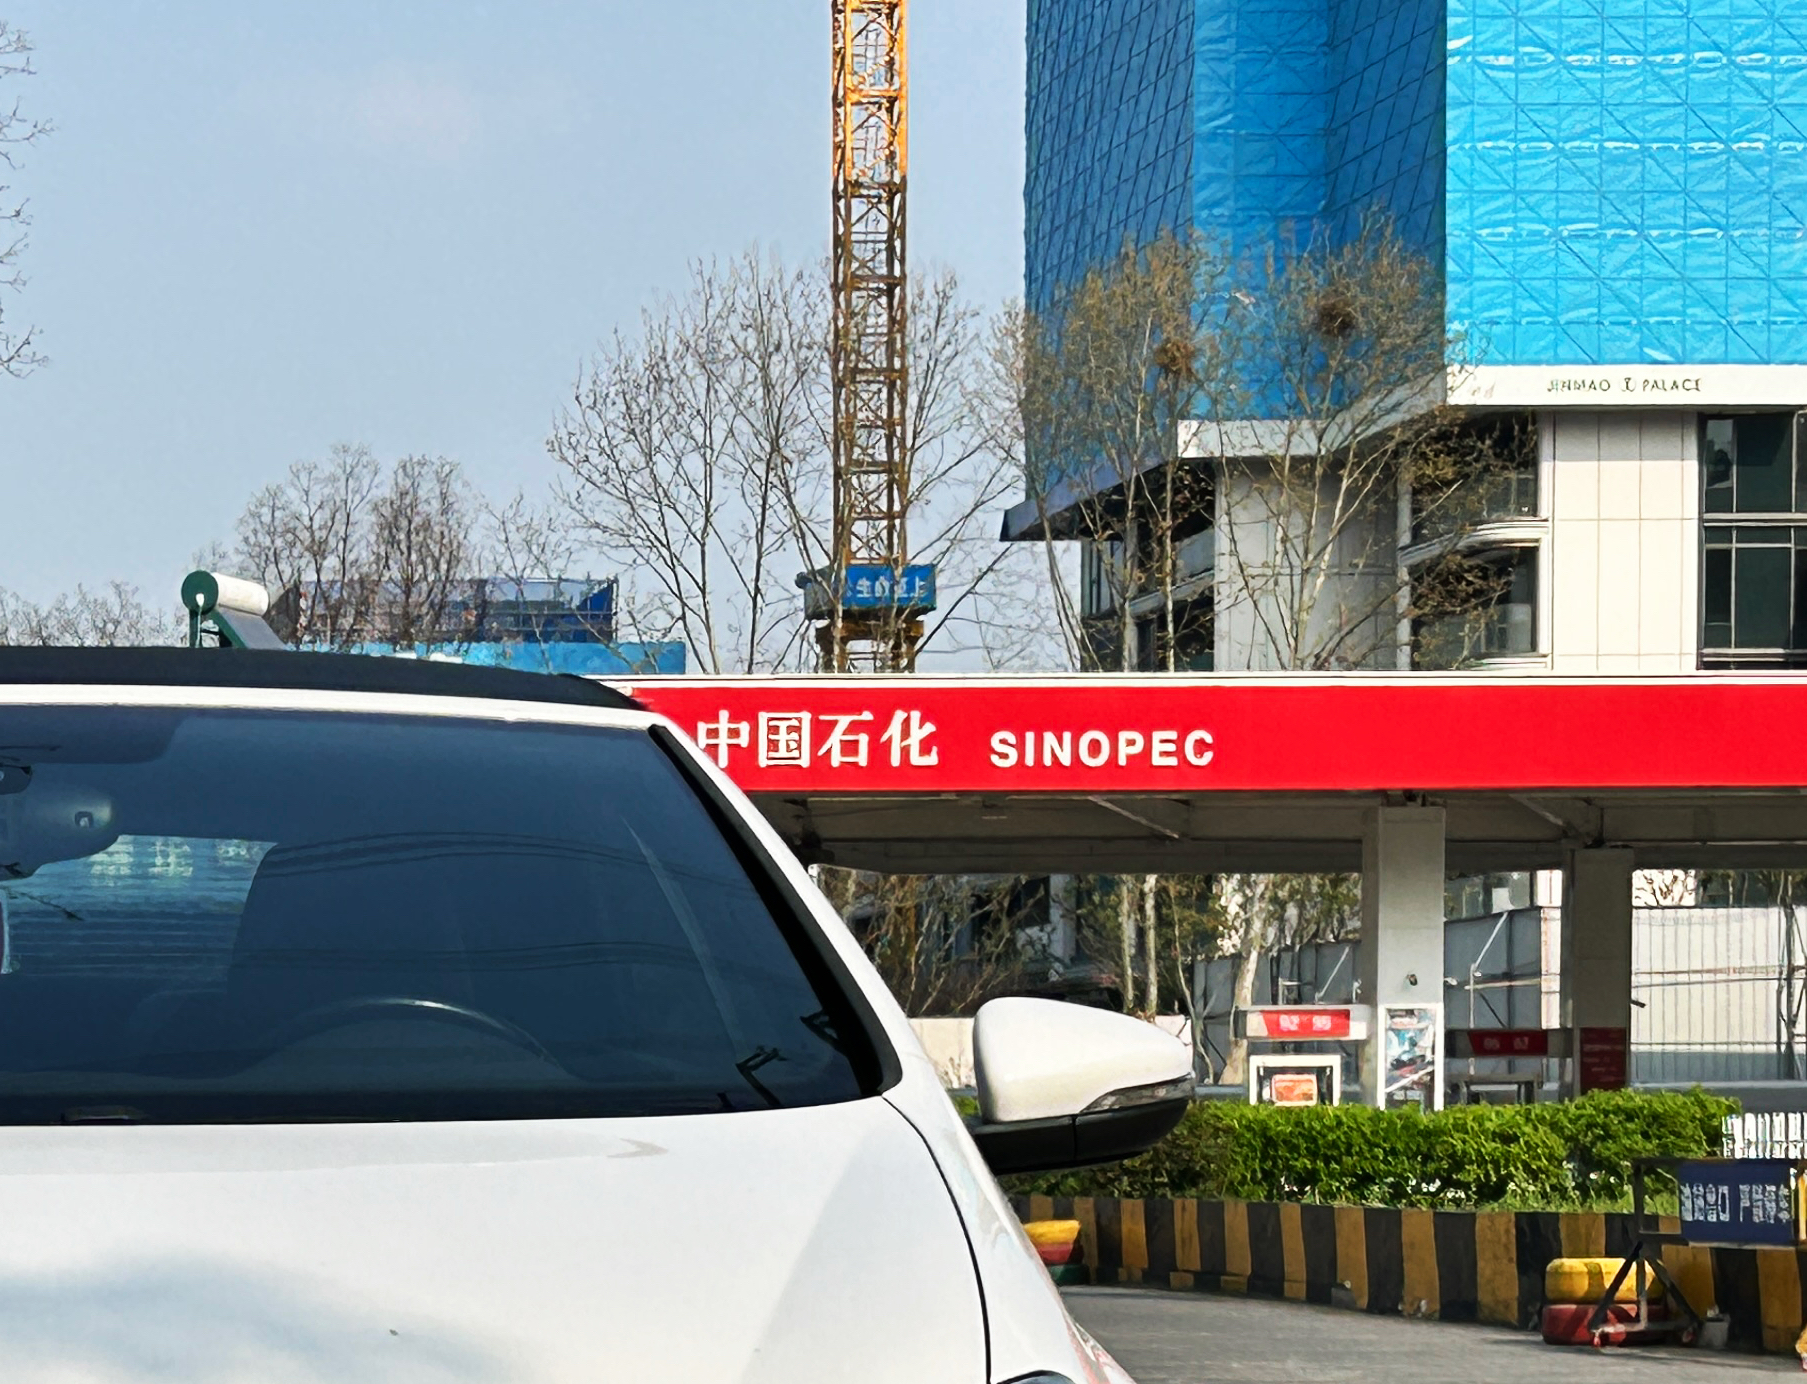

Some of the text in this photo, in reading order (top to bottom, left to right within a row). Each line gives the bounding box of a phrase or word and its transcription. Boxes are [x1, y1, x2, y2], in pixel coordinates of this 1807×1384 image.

[695, 709, 939, 769] 中国石化
[990, 729, 1215, 769] SINOPEC
